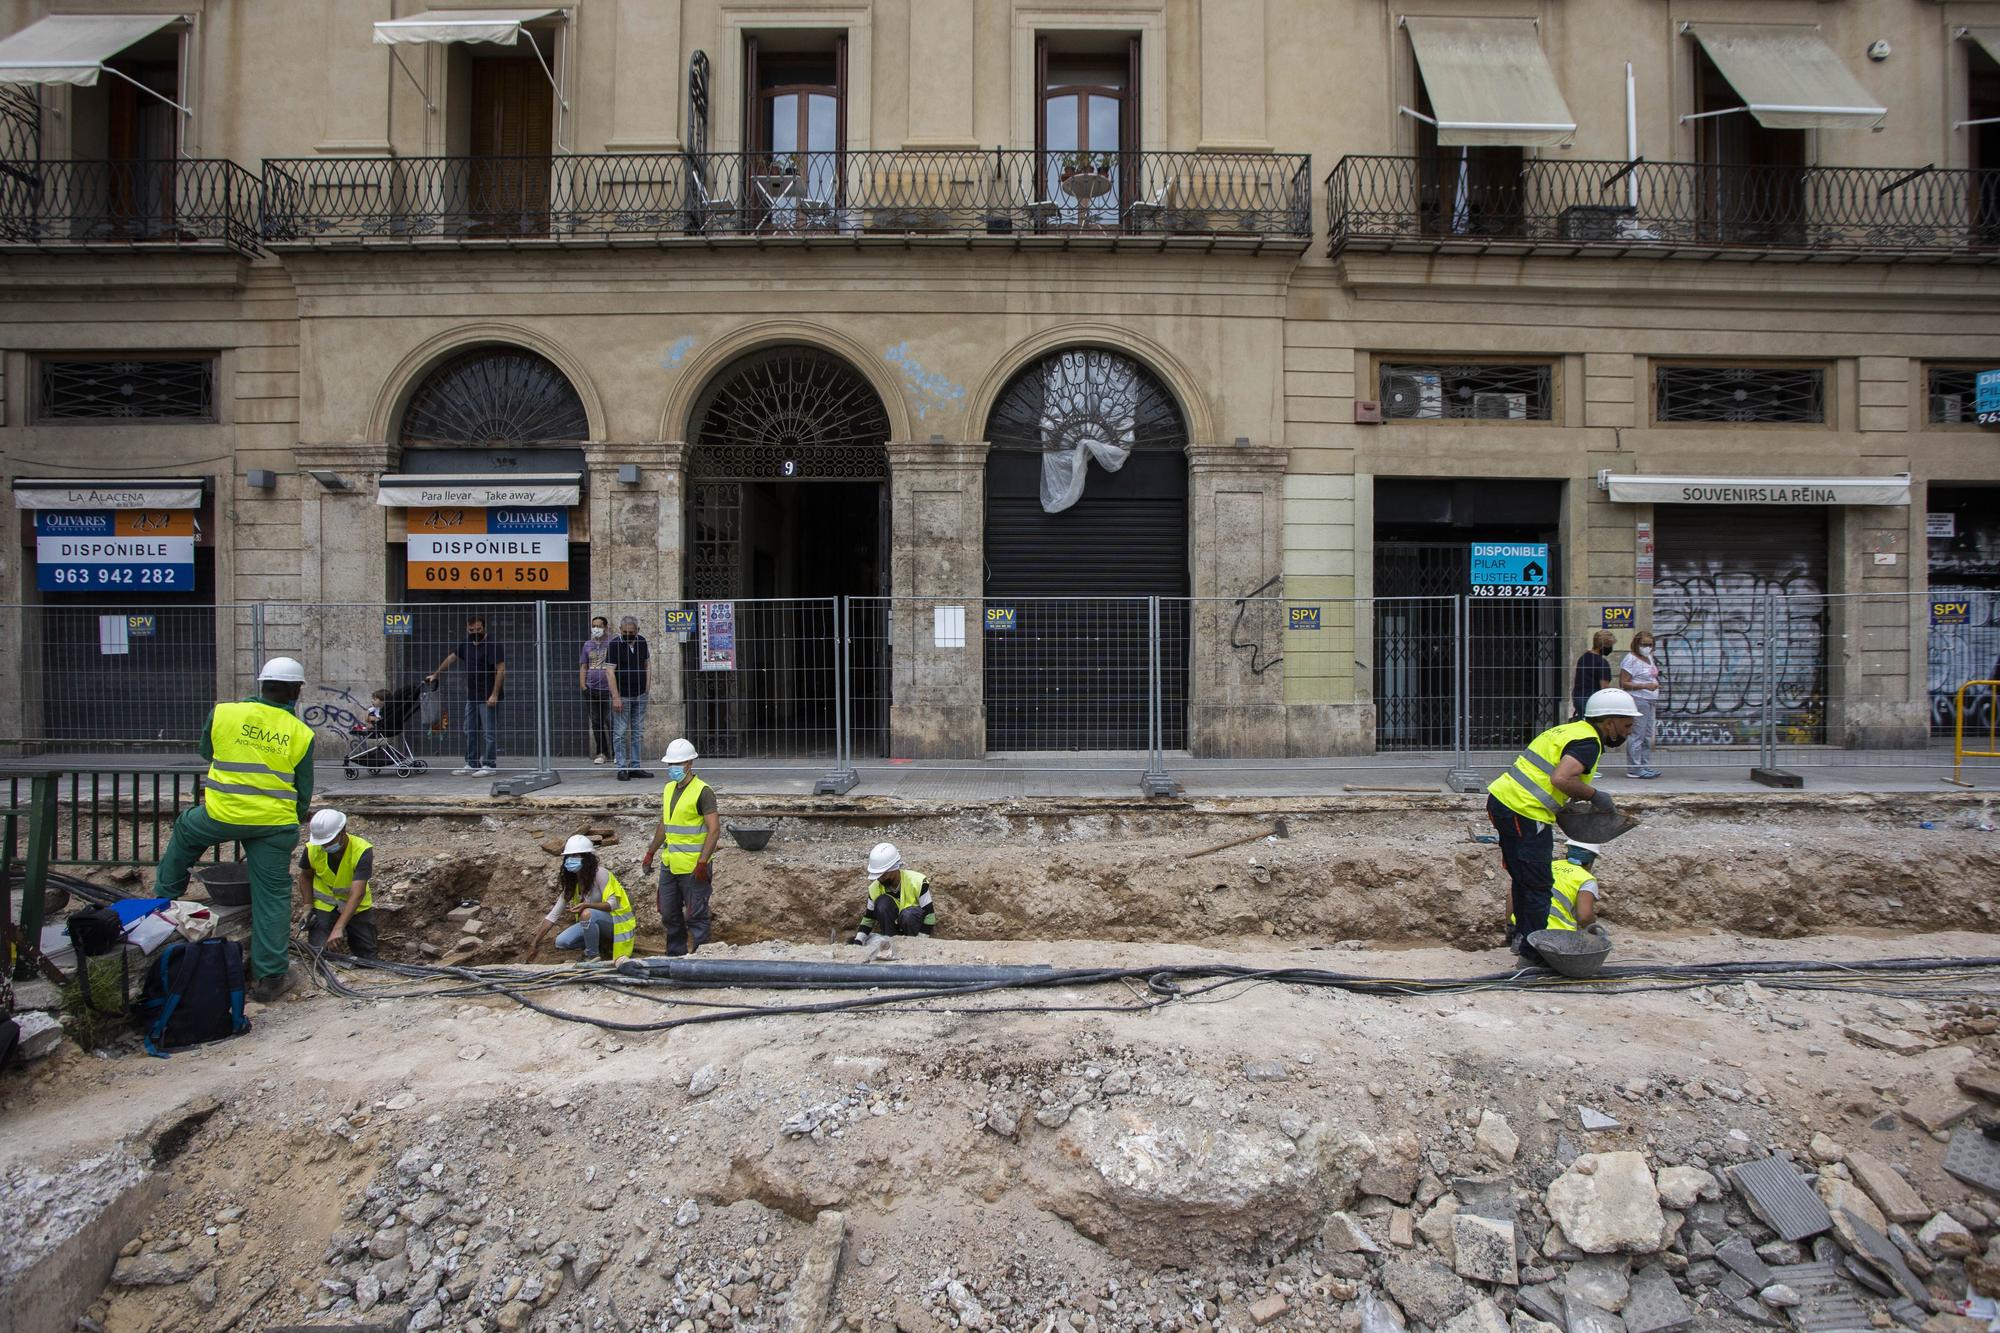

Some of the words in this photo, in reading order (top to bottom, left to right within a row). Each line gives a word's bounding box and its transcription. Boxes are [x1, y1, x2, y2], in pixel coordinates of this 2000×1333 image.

[785, 461, 794, 475] 9
[68, 490, 85, 504] LA
[89, 490, 145, 504] ALACENA
[421, 491, 443, 501] Para
[444, 490, 472, 500] llevar
[485, 491, 507, 500] Take
[509, 491, 536, 502] away
[1682, 488, 1767, 501] SOUVENIRS
[1770, 489, 1788, 502] LA
[46, 513, 106, 526] OLIVARES
[497, 510, 558, 523] OLIVARES
[62, 543, 168, 557] DISPONIBLE
[432, 541, 542, 554] DISPONIBLE
[1474, 546, 1545, 557] DISPONIBLE
[1474, 559, 1506, 569] PILAR
[55, 568, 90, 583] 963
[98, 568, 133, 583] 942
[141, 568, 175, 583] 282
[425, 567, 460, 582] 609
[470, 567, 503, 582] 601
[515, 567, 549, 582] 550
[1474, 572, 1518, 582] FUSTER
[1472, 585, 1495, 596] 963
[1497, 585, 1513, 597] 28
[1515, 585, 1530, 597] 24
[1532, 586, 1547, 597] 22
[987, 609, 1014, 620] SPV
[1291, 609, 1318, 620] SPV
[1604, 608, 1632, 619] SPV
[1933, 603, 1967, 615] SPV
[129, 616, 152, 627] SPV
[386, 614, 410, 625] SPV
[667, 611, 693, 622] SPV
[241, 724, 290, 746] SEMAR
